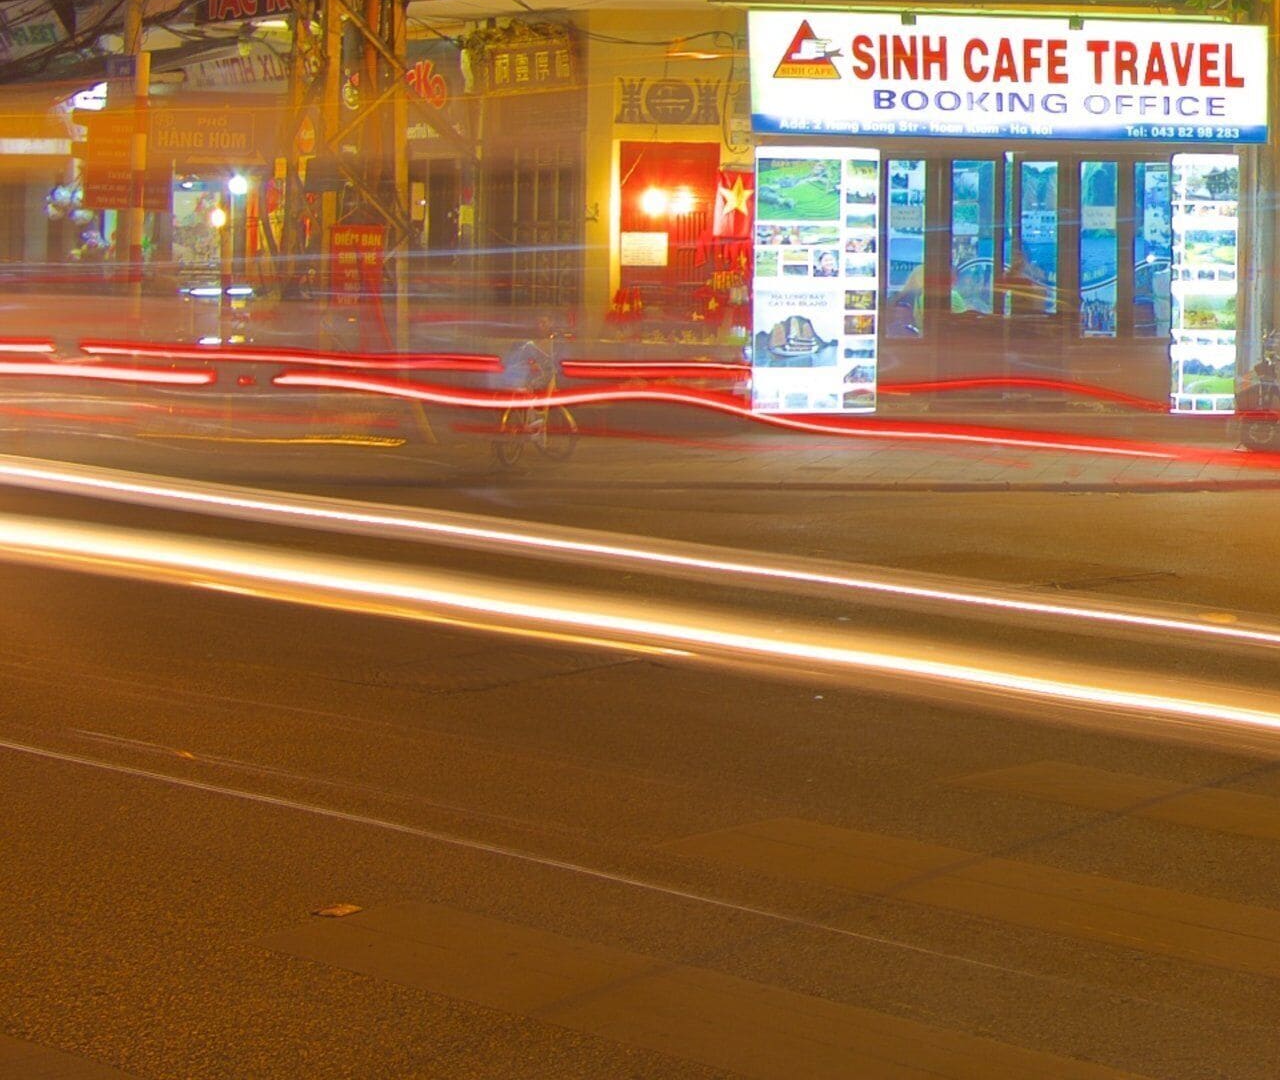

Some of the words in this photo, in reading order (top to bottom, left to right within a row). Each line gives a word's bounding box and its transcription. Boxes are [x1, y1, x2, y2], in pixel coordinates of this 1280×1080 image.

[852, 34, 947, 81] SINH
[963, 37, 1069, 84] CAFE
[1086, 40, 1245, 88] TRAVEL
[780, 67, 806, 76] SINH
[806, 67, 833, 77] CAFE
[873, 89, 1068, 114] BOOKING
[1084, 94, 1226, 117] OFFICE
[1126, 125, 1148, 138] Tel:
[1151, 126, 1175, 138] 043
[1178, 127, 1194, 138] 82
[1216, 128, 1240, 140] 283
